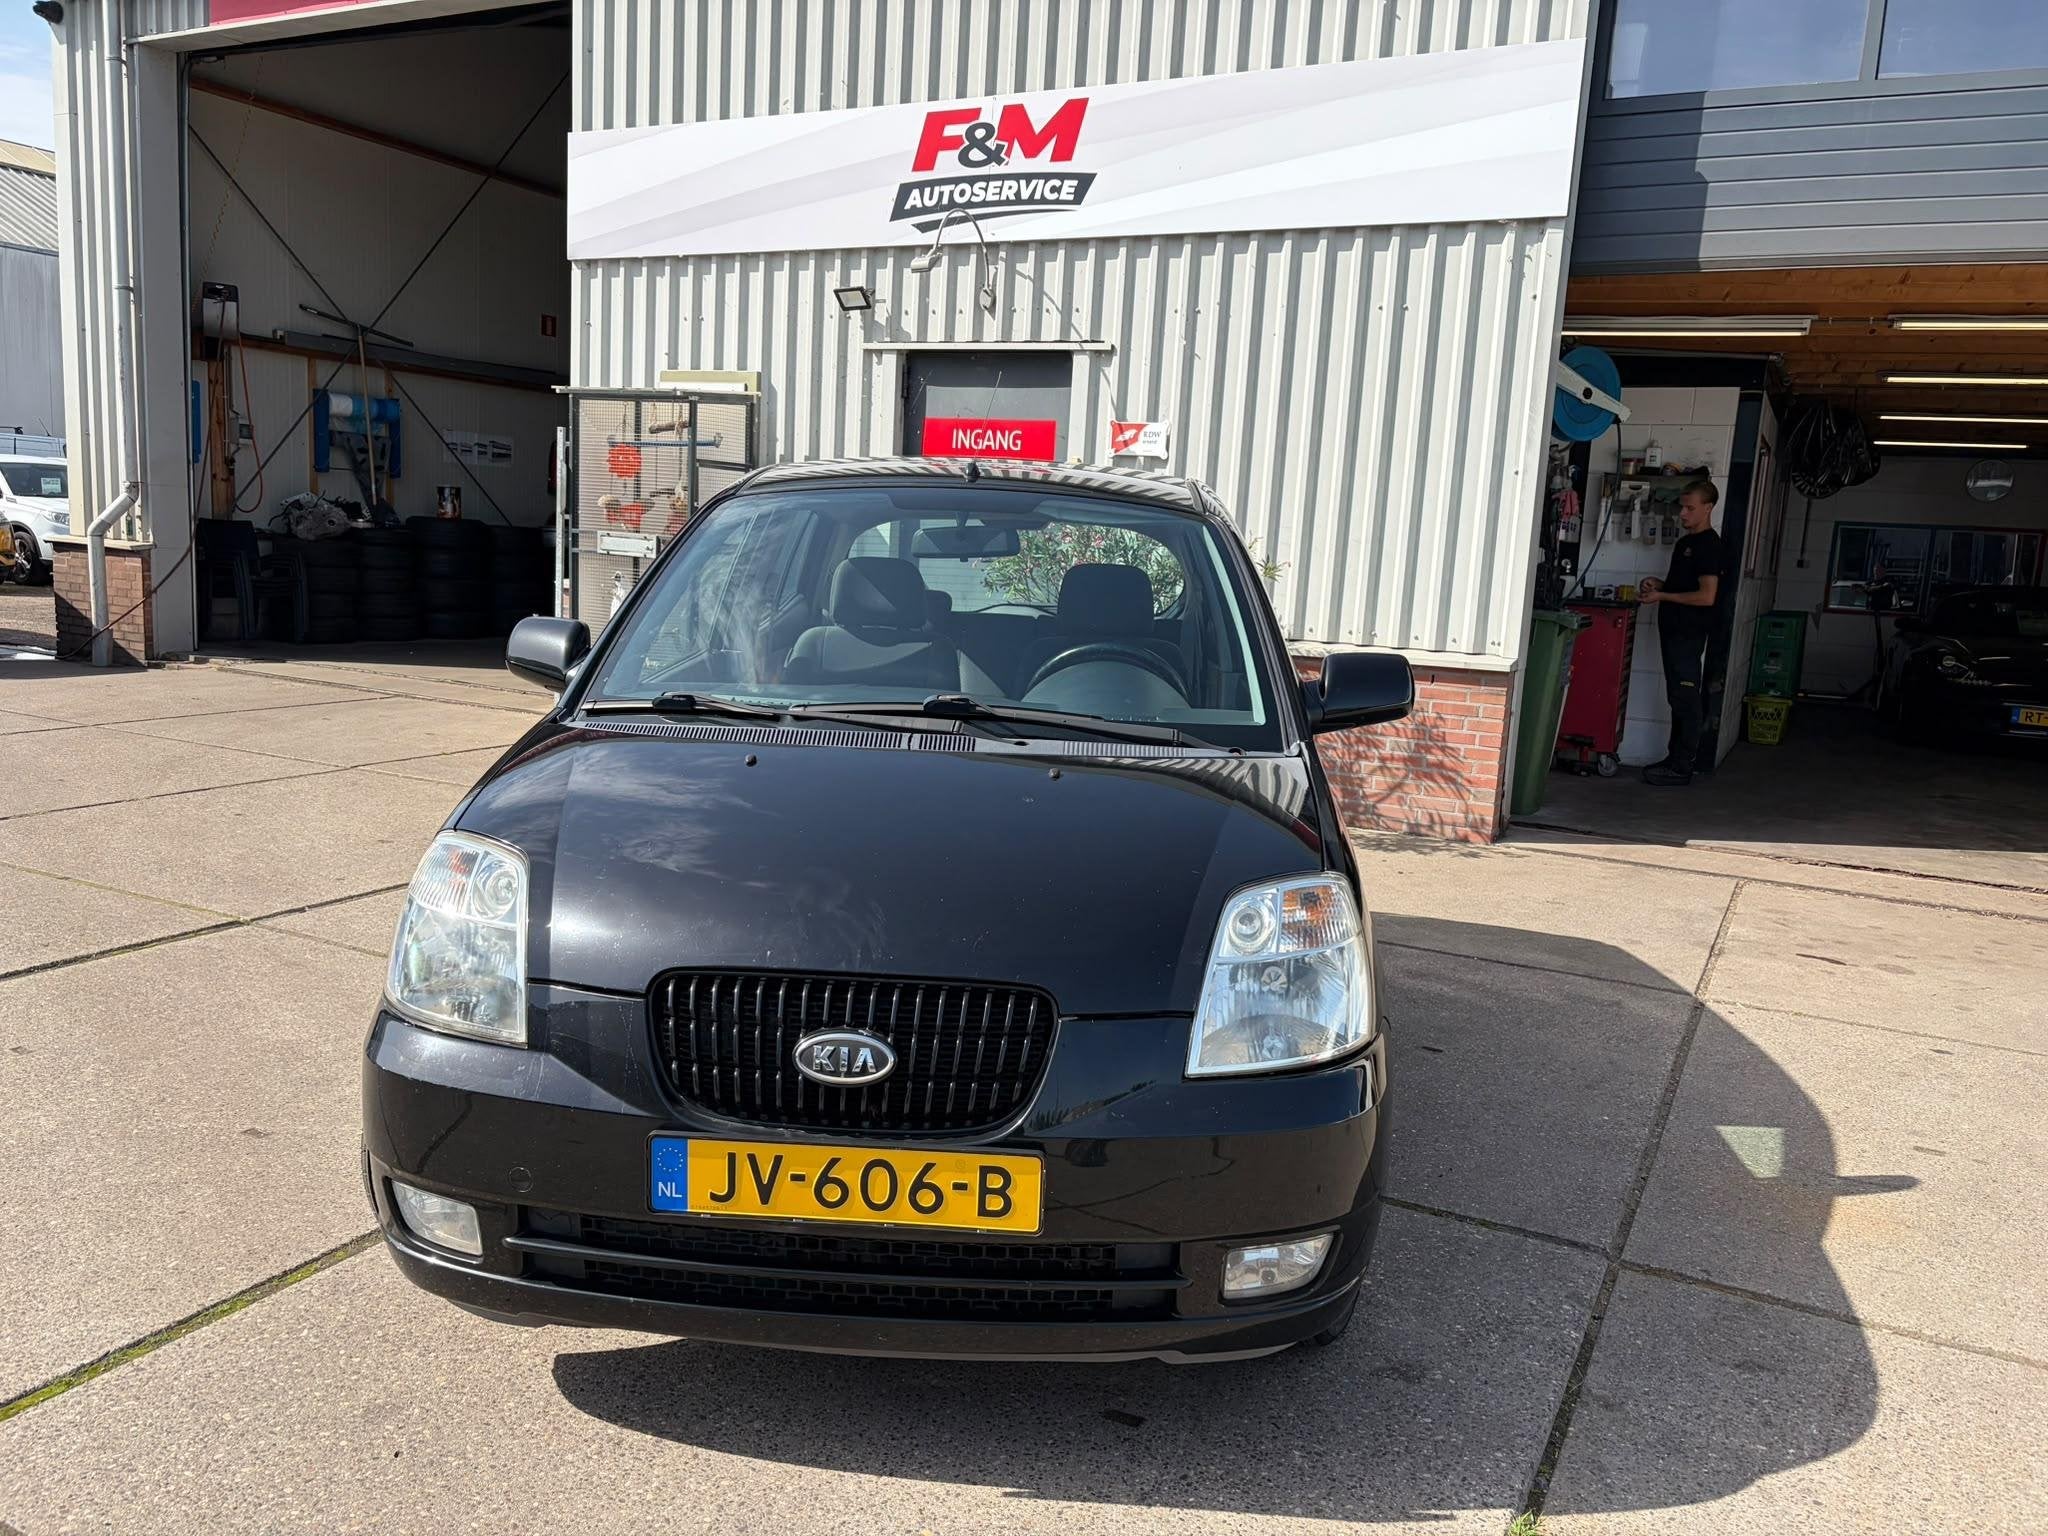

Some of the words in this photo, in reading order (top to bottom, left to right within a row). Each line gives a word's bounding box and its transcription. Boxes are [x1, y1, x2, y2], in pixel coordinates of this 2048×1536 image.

[911, 97, 1089, 172] F&M
[904, 178, 1078, 210] AUTOSERVICE
[952, 428, 1022, 450] INGANG
[812, 1044, 876, 1073] KIA
[658, 1181, 682, 1198] NL
[709, 1152, 1012, 1218] JV-606-B
